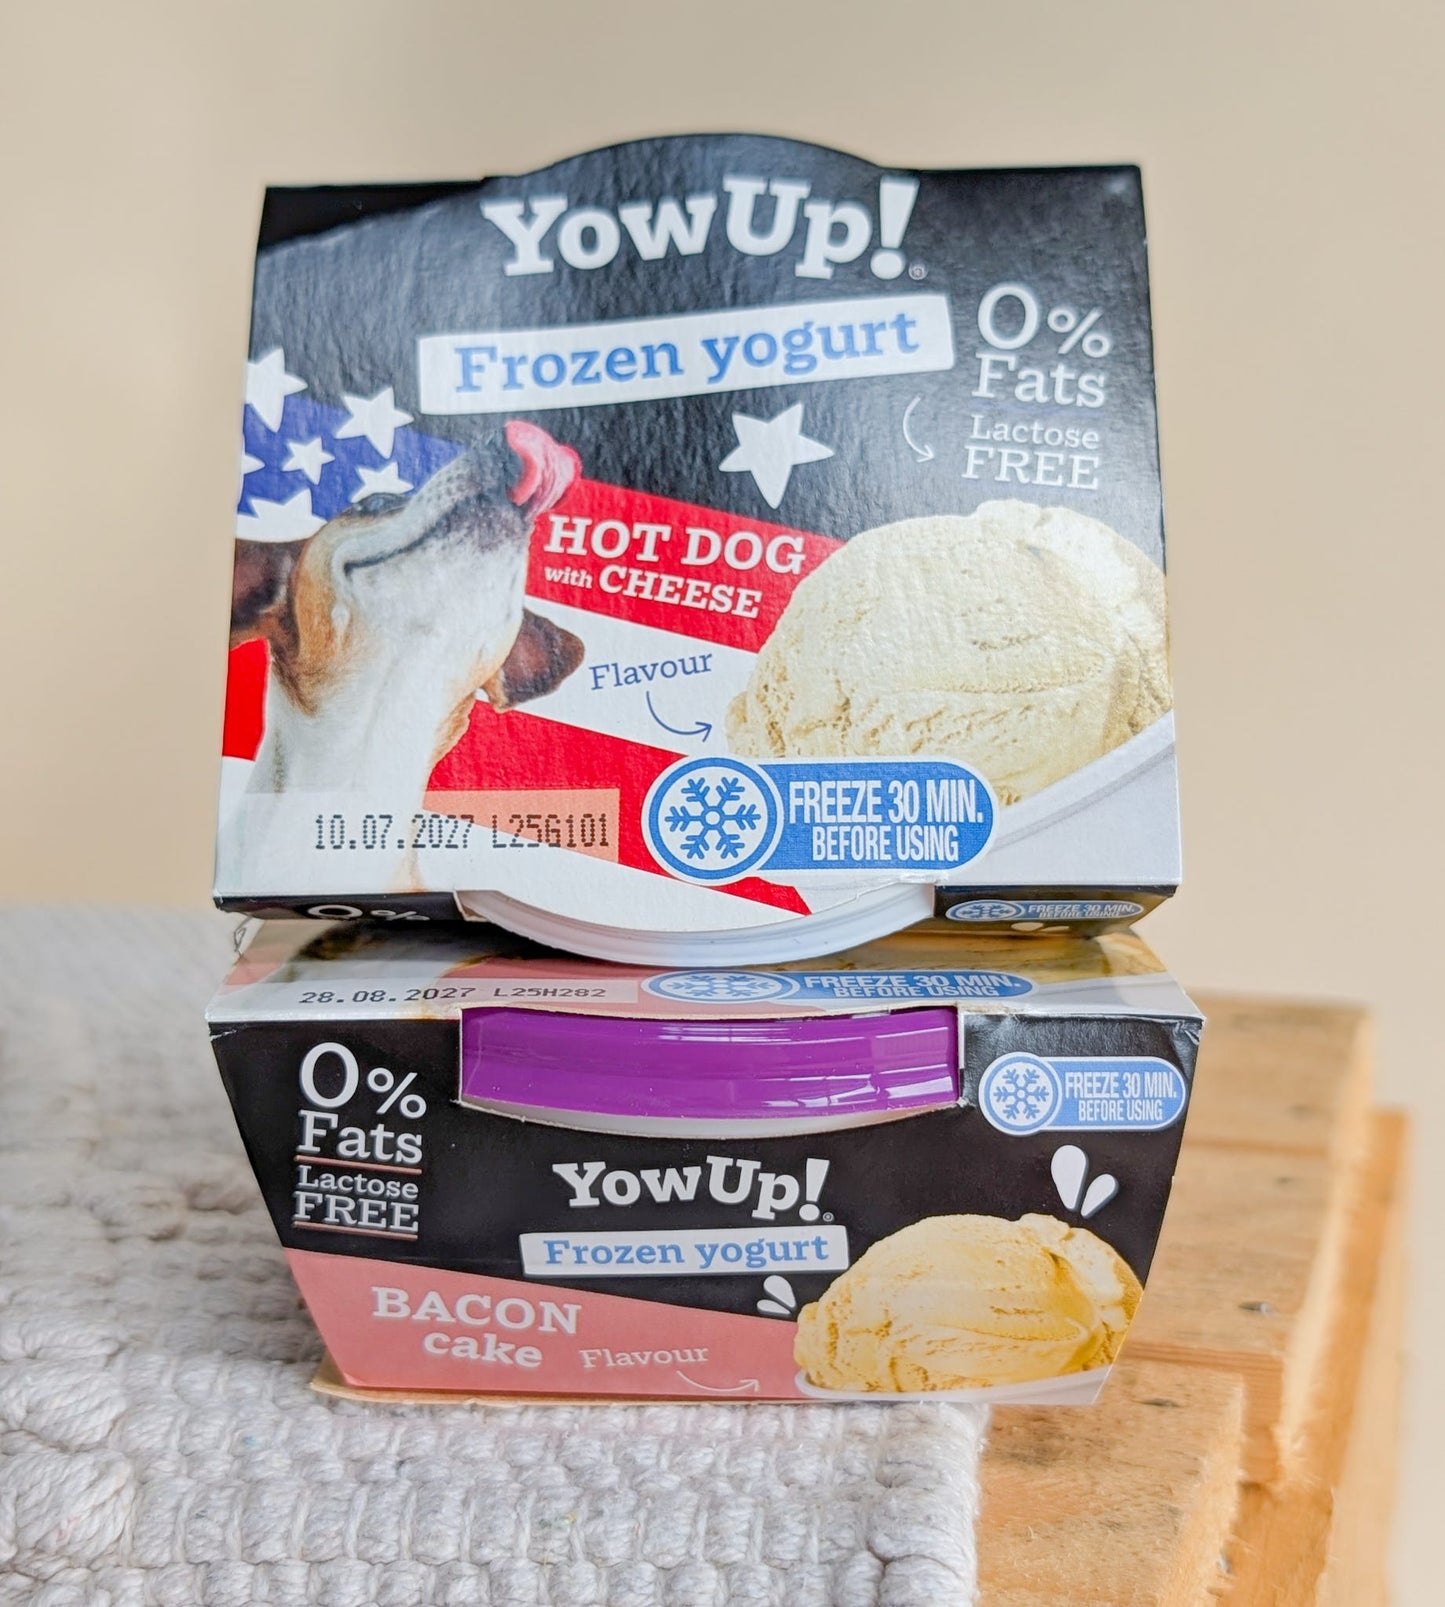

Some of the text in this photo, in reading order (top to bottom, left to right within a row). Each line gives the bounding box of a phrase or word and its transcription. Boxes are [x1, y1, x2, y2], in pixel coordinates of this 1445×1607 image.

[481, 172, 920, 280] YowUp!
[977, 285, 1112, 358] 0%
[454, 312, 921, 393] Frozen yogurt
[971, 352, 1107, 408] Fats
[969, 414, 1100, 450] Lactose
[961, 445, 1099, 490] FREE
[544, 514, 806, 576] HOT DOG
[544, 564, 762, 619] with CHEESE
[589, 653, 713, 691] Flavour
[789, 779, 984, 824] FREEZE 30 MIN.
[315, 813, 474, 850] 10.07.2027
[812, 825, 959, 862] BEFORE USING
[1028, 904, 1081, 913] FREEZE
[1083, 903, 1102, 912] 30
[300, 986, 607, 1004] 28.08.2027 L25H282
[806, 974, 1021, 989] FREEZE 30 MIN.
[835, 986, 999, 998] BEFORE USING
[300, 1042, 427, 1119] 0%
[1065, 1072, 1177, 1098] FREEZE 30 MIN.
[1079, 1099, 1162, 1120] BEFORE USING
[297, 1109, 423, 1164] Fats
[298, 1165, 419, 1200] Lactose
[552, 1156, 830, 1222] YowUp!
[294, 1190, 419, 1232] FREE
[544, 1235, 829, 1269] Frozen yogurt
[371, 1286, 582, 1335] BACON
[424, 1331, 543, 1369] cake
[580, 1345, 709, 1370] Flavour
